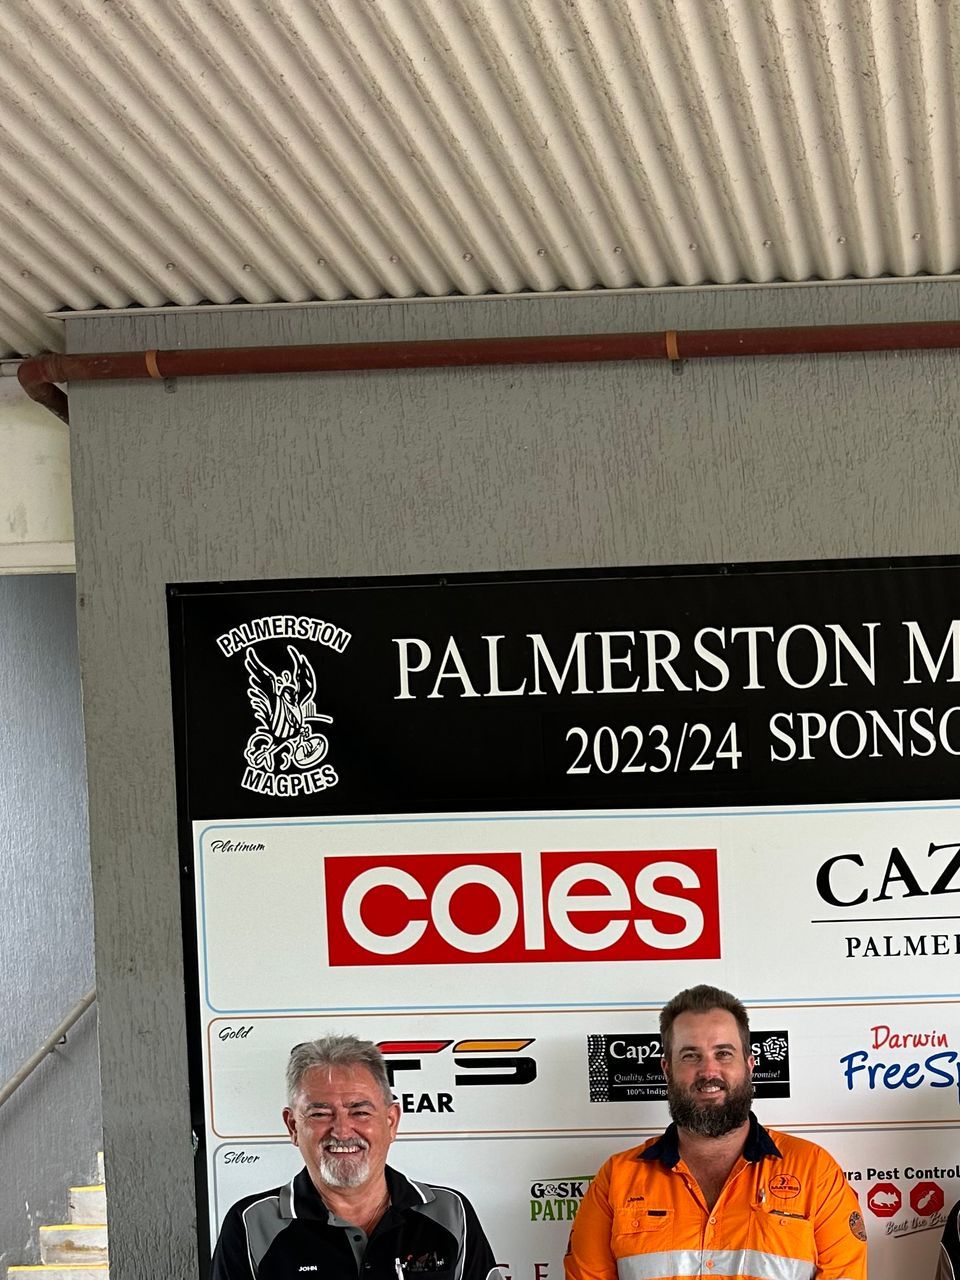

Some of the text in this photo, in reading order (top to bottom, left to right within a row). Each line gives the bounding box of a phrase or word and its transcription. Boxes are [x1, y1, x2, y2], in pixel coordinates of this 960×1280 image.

[216, 615, 352, 657] PALMERSTON
[391, 622, 881, 700] PALMERSTON
[565, 721, 743, 774] 2023/24
[241, 764, 339, 796] MAGPIES
[210, 839, 265, 852] Platinum
[342, 852, 705, 954] coles
[218, 1026, 254, 1041] Gold
[870, 1025, 949, 1049] Darwin
[391, 1092, 455, 1113] EAR
[626, 1088, 645, 1096] 100%
[223, 1151, 261, 1165] Silver
[867, 1167, 900, 1180] Pest
[530, 1199, 580, 1222] PATR
